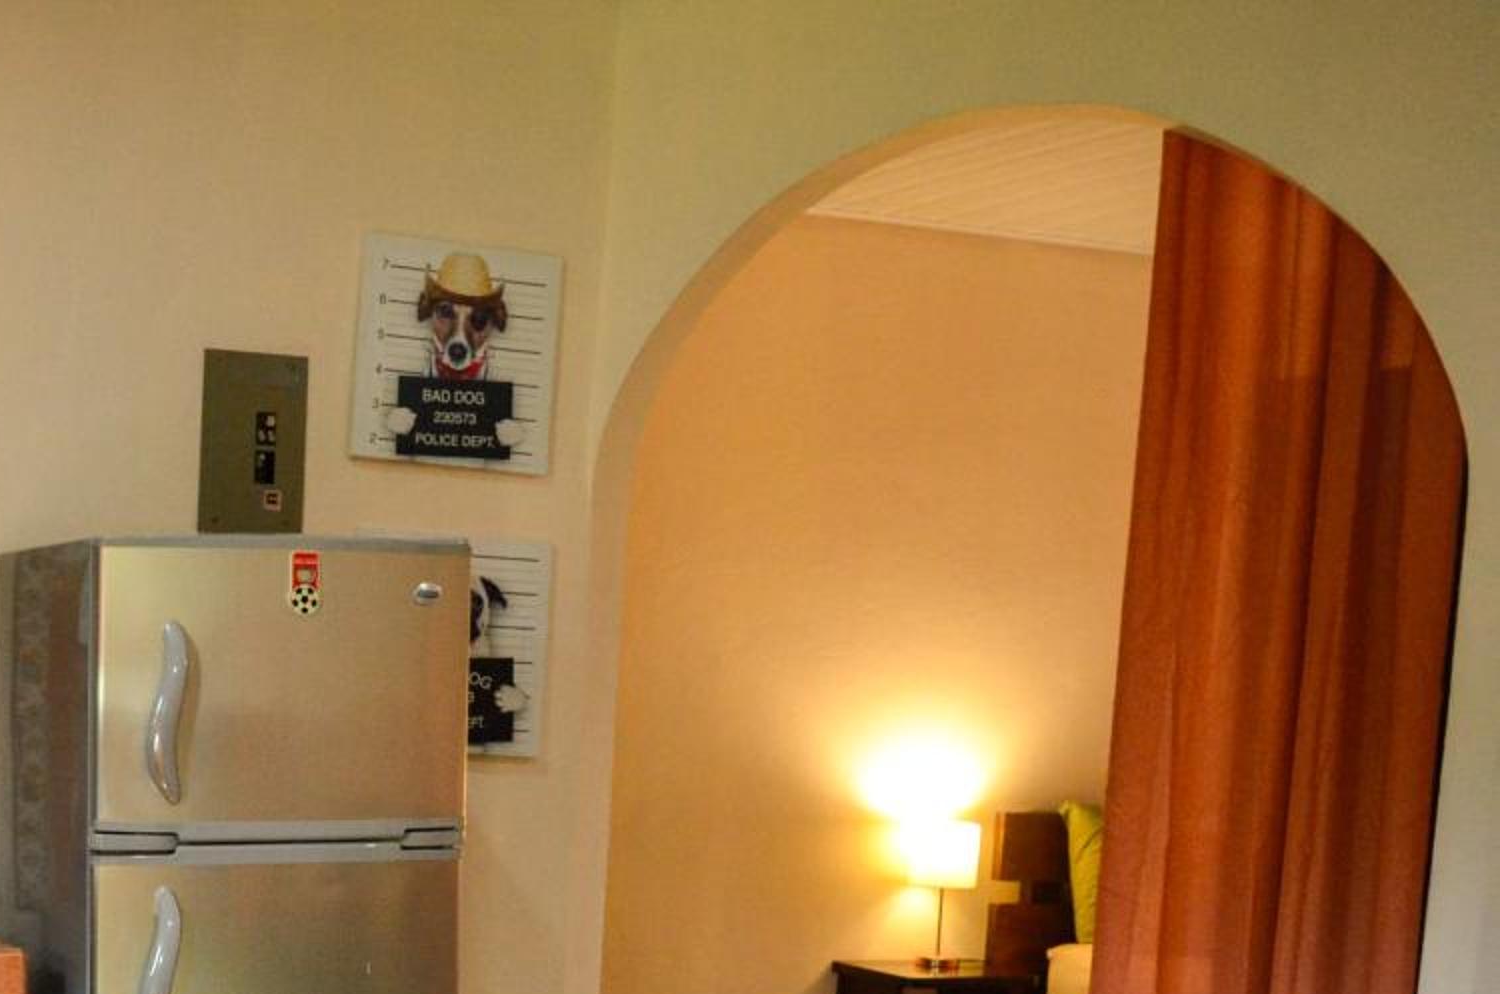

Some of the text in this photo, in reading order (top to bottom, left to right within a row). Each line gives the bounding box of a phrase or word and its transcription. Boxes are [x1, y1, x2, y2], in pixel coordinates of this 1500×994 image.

[422, 388, 485, 405] BAD DOG
[415, 432, 460, 447] POLICE
